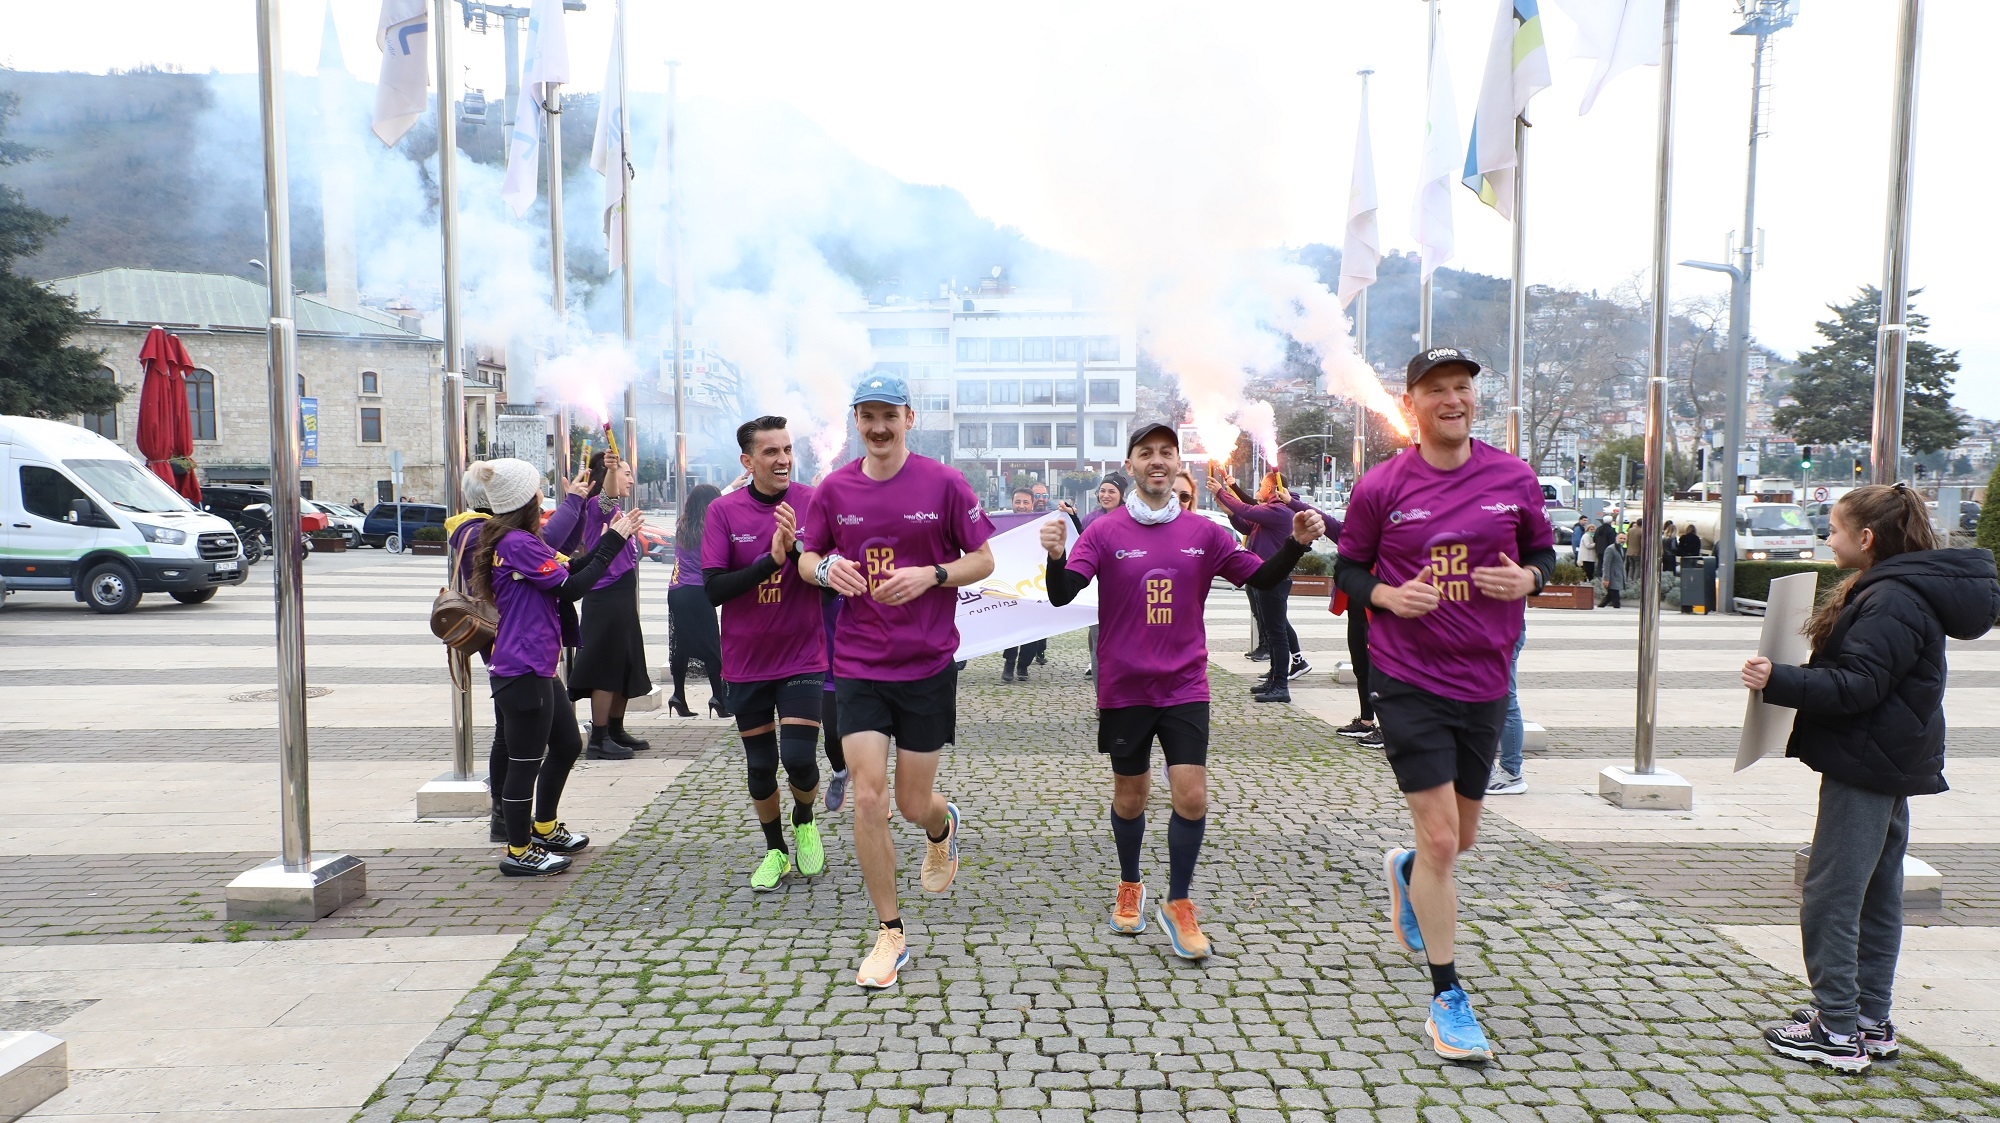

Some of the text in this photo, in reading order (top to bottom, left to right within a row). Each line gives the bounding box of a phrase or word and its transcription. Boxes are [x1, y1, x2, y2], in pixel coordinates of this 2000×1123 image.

[865, 547, 895, 575] 52
[1430, 544, 1468, 577] 52
[758, 585, 782, 604] km
[1146, 579, 1173, 604] 52
[1431, 576, 1470, 602] km
[969, 600, 1018, 615] running
[1146, 604, 1173, 624] km
